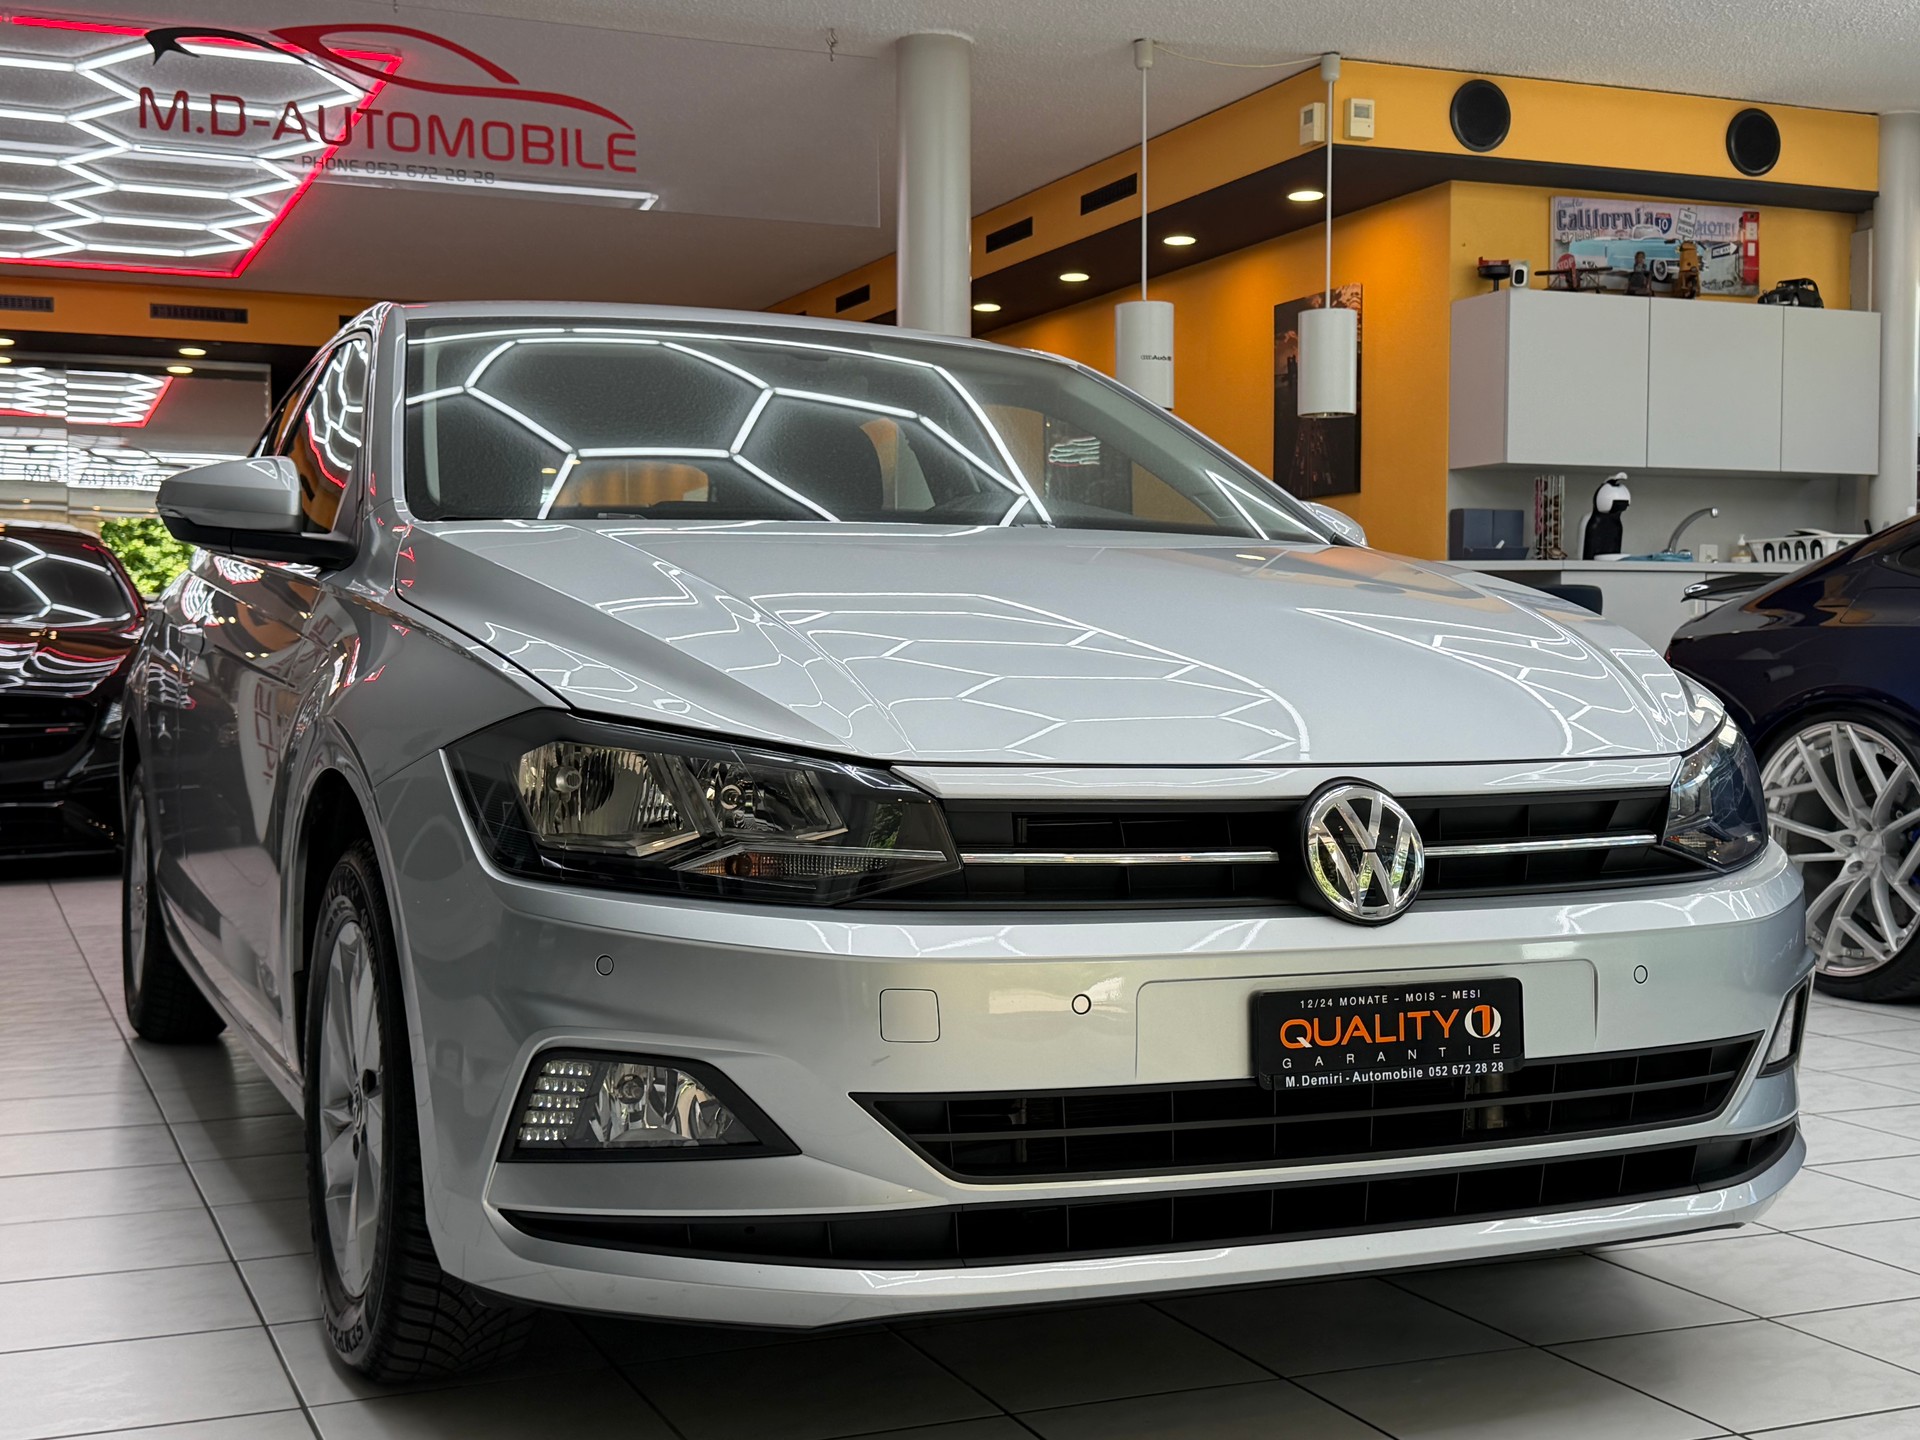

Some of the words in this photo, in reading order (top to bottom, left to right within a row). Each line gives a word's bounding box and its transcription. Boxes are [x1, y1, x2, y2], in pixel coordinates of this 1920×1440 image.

[138, 85, 637, 174] M.D-AUTOMOBILE
[301, 155, 359, 173] PHONE
[365, 161, 399, 177] 052
[406, 164, 439, 180] 672
[444, 168, 468, 182] 28
[473, 170, 496, 185] 28
[1300, 999, 1333, 1009] 12/24
[1339, 994, 1389, 1007] MONATE
[1405, 991, 1436, 1003] MOIS
[1452, 989, 1481, 1000] MESI
[1280, 1009, 1460, 1049] QUALITY
[1352, 1067, 1423, 1083] Automobile
[1428, 1065, 1448, 1077] 052
[1452, 1063, 1471, 1075] 672
[1474, 1062, 1488, 1073] 28
[1491, 1060, 1504, 1072] 28
